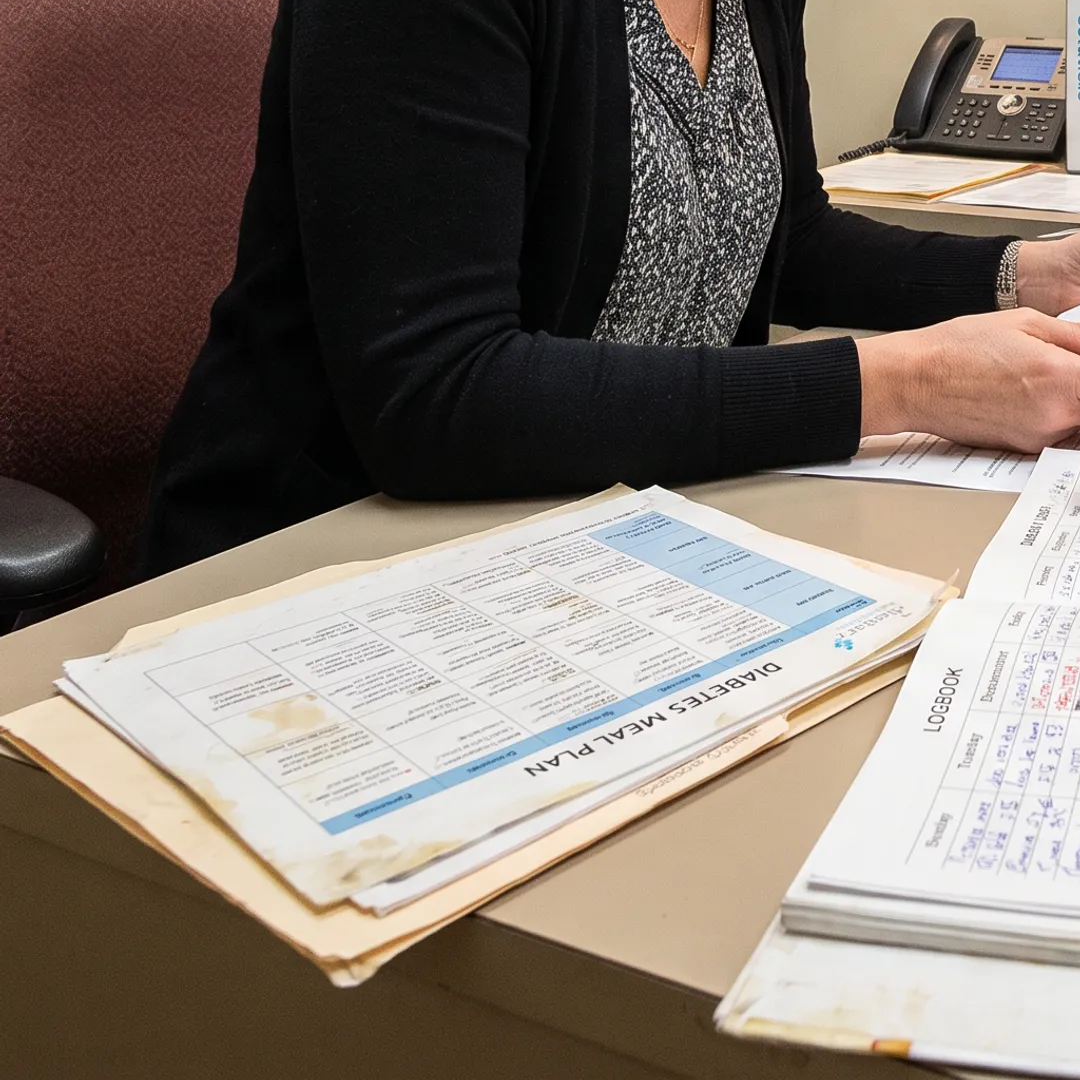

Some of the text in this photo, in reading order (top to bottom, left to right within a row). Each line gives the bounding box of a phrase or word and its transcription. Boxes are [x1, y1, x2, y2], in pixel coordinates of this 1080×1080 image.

[523, 662, 783, 777] DIABETES MEAL PLAN
[923, 666, 963, 733] LOGBOOK
